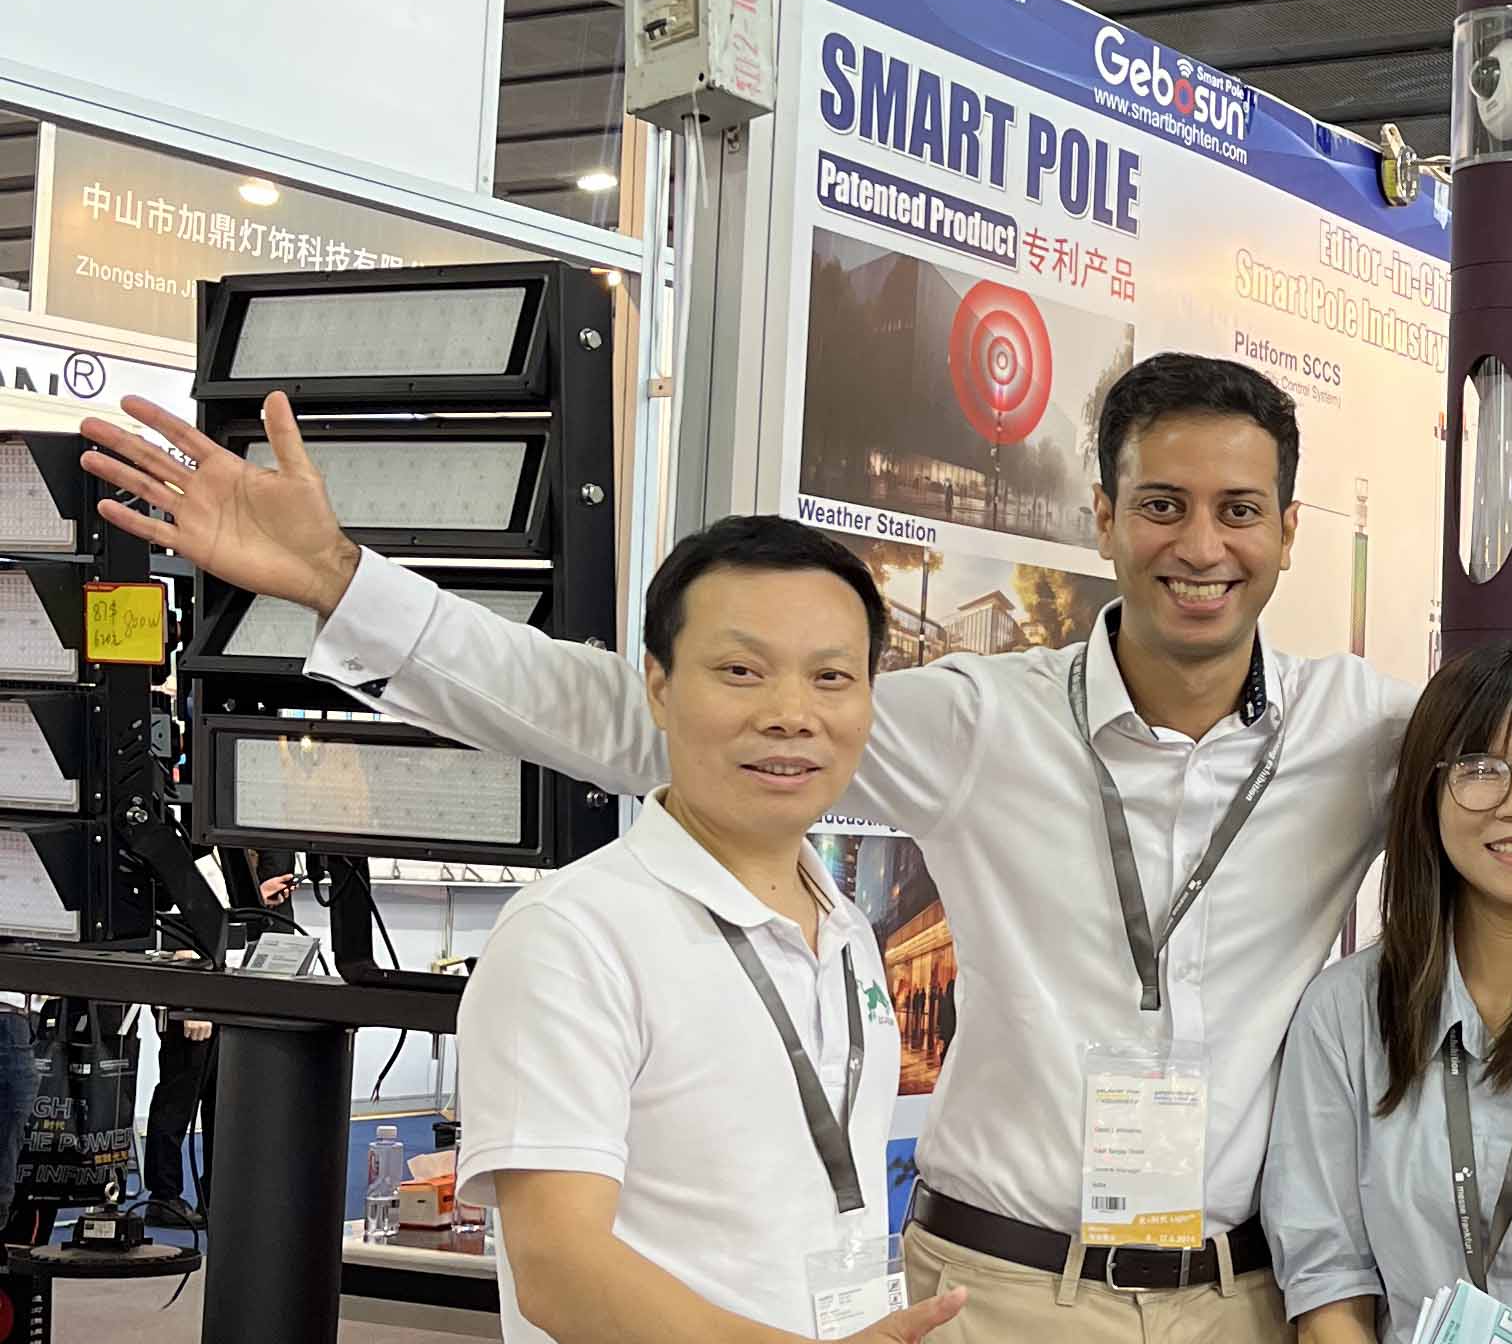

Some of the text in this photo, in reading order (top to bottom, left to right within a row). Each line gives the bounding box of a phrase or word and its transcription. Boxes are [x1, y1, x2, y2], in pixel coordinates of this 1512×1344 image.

[1094, 26, 1245, 141] Gebosun
[1196, 66, 1244, 99] Smart Pole
[819, 32, 1143, 239] SMART POLE
[1093, 87, 1248, 165] www.smartbrighten.com
[82, 181, 424, 272] 中山市加鼎灯饰科技有限
[820, 158, 1017, 259] Patented Product
[75, 256, 177, 296] Zhongshan
[1022, 227, 1136, 304] 专利产品
[1319, 218, 1383, 287] Editor
[1235, 248, 1449, 374] Smart Pole Industry
[1234, 330, 1342, 387] Platform SCCS
[798, 497, 937, 544] Weather Station
